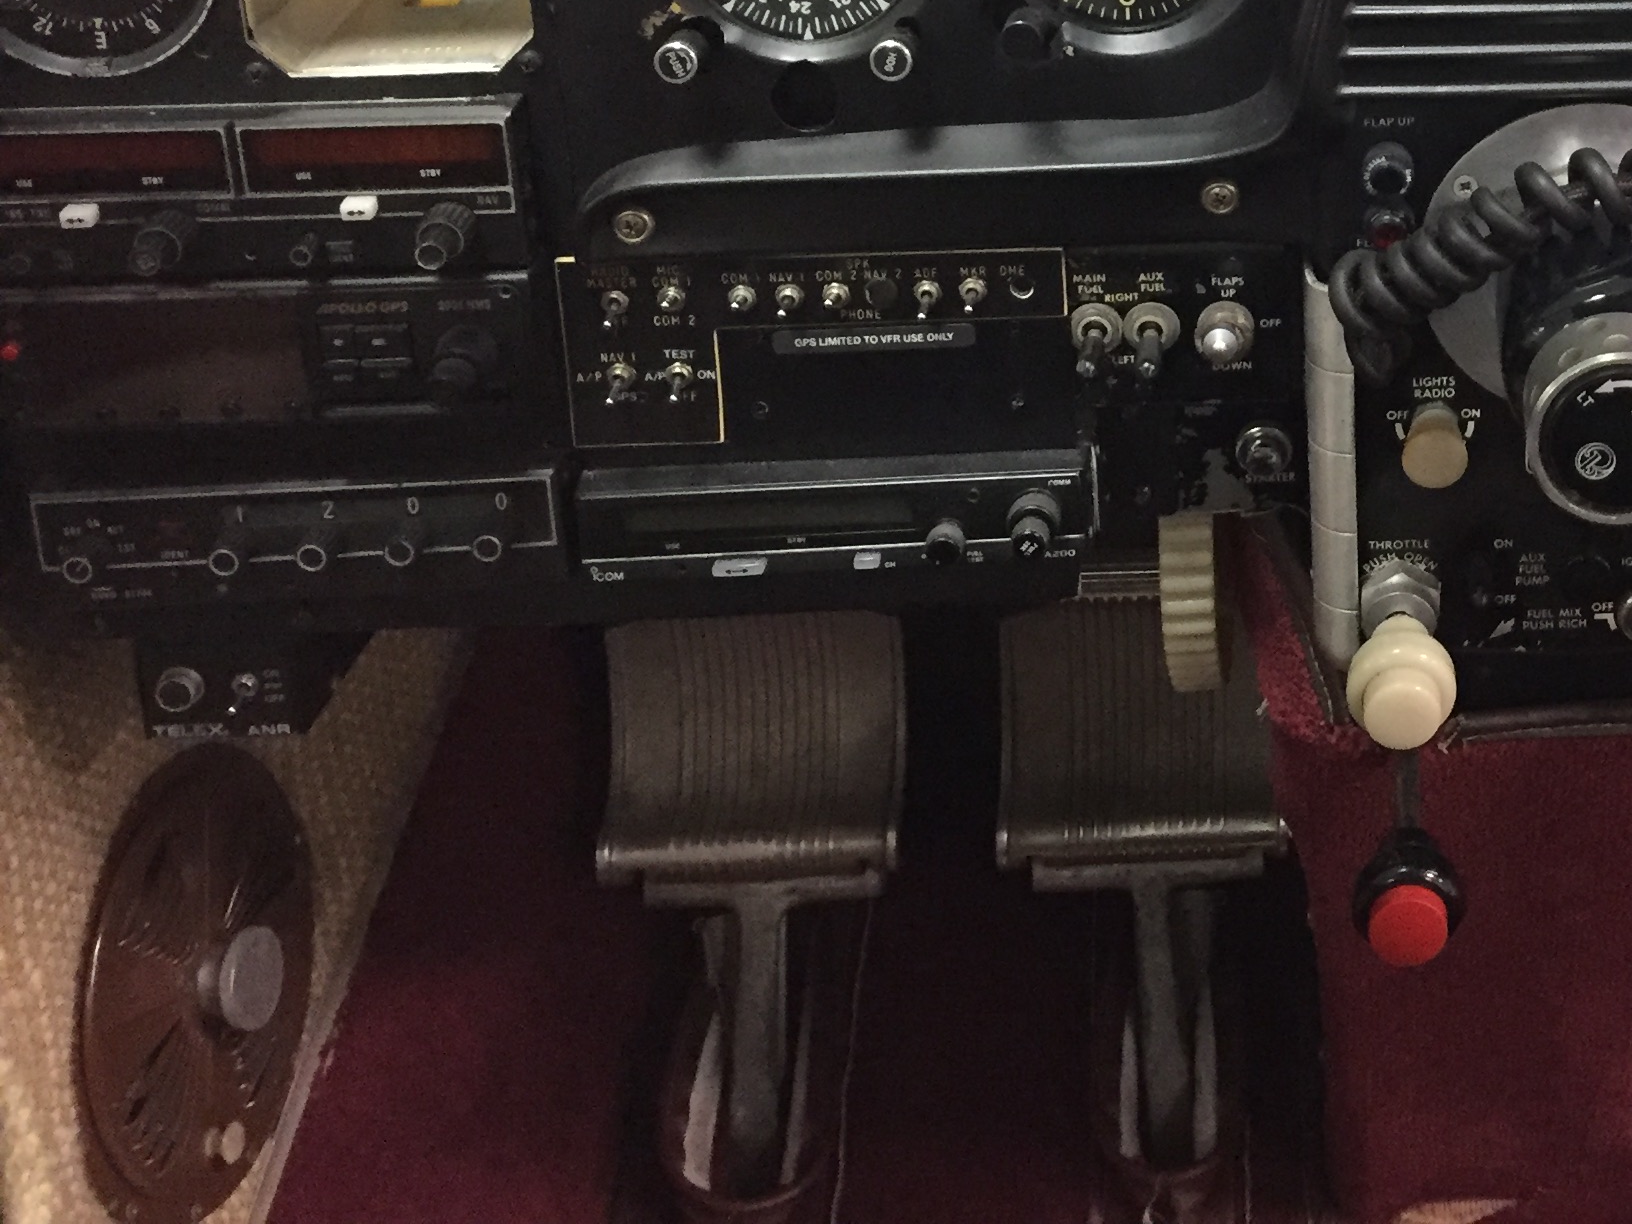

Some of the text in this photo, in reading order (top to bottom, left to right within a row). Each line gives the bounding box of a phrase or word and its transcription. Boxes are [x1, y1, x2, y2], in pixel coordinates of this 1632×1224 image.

[788, 0, 812, 14] 24
[960, 266, 986, 276] MKR
[1000, 265, 1025, 276] DME
[721, 273, 749, 283] COM
[769, 272, 794, 282] NAV
[815, 271, 842, 282] COM
[1073, 274, 1106, 283] MAIN
[1138, 272, 1164, 282] AUX
[1211, 276, 1244, 286] FLAPS
[1078, 285, 1104, 294] FUEL
[1141, 283, 1166, 292] FUEL
[1104, 292, 1139, 302] RIGHT
[1221, 289, 1237, 298] UP
[840, 308, 881, 319] PHONE
[653, 315, 681, 326] COM
[1260, 318, 1281, 328] OFF
[794, 332, 954, 347] GPS LIMITED TO VFR USE ONLY
[601, 352, 624, 363] NAV
[663, 349, 696, 359] TEST
[1111, 355, 1135, 364] LEFT
[697, 370, 716, 380] ON
[1412, 376, 1456, 388] LIGHTS
[1413, 387, 1456, 398] RADIO
[1576, 390, 1595, 407] LT
[1386, 408, 1480, 420] OFF ON
[1368, 539, 1429, 550] THROTTLE
[1493, 539, 1513, 549] ON
[1362, 552, 1398, 573] PUSH
[1519, 553, 1546, 563] AUX
[1519, 563, 1546, 574] FUEL
[1515, 576, 1550, 586] PUMP
[1494, 594, 1517, 604] OFF
[1591, 601, 1614, 612] OFF
[1527, 608, 1582, 619] FUEL MIX
[1522, 619, 1587, 630] PUSH RICH
